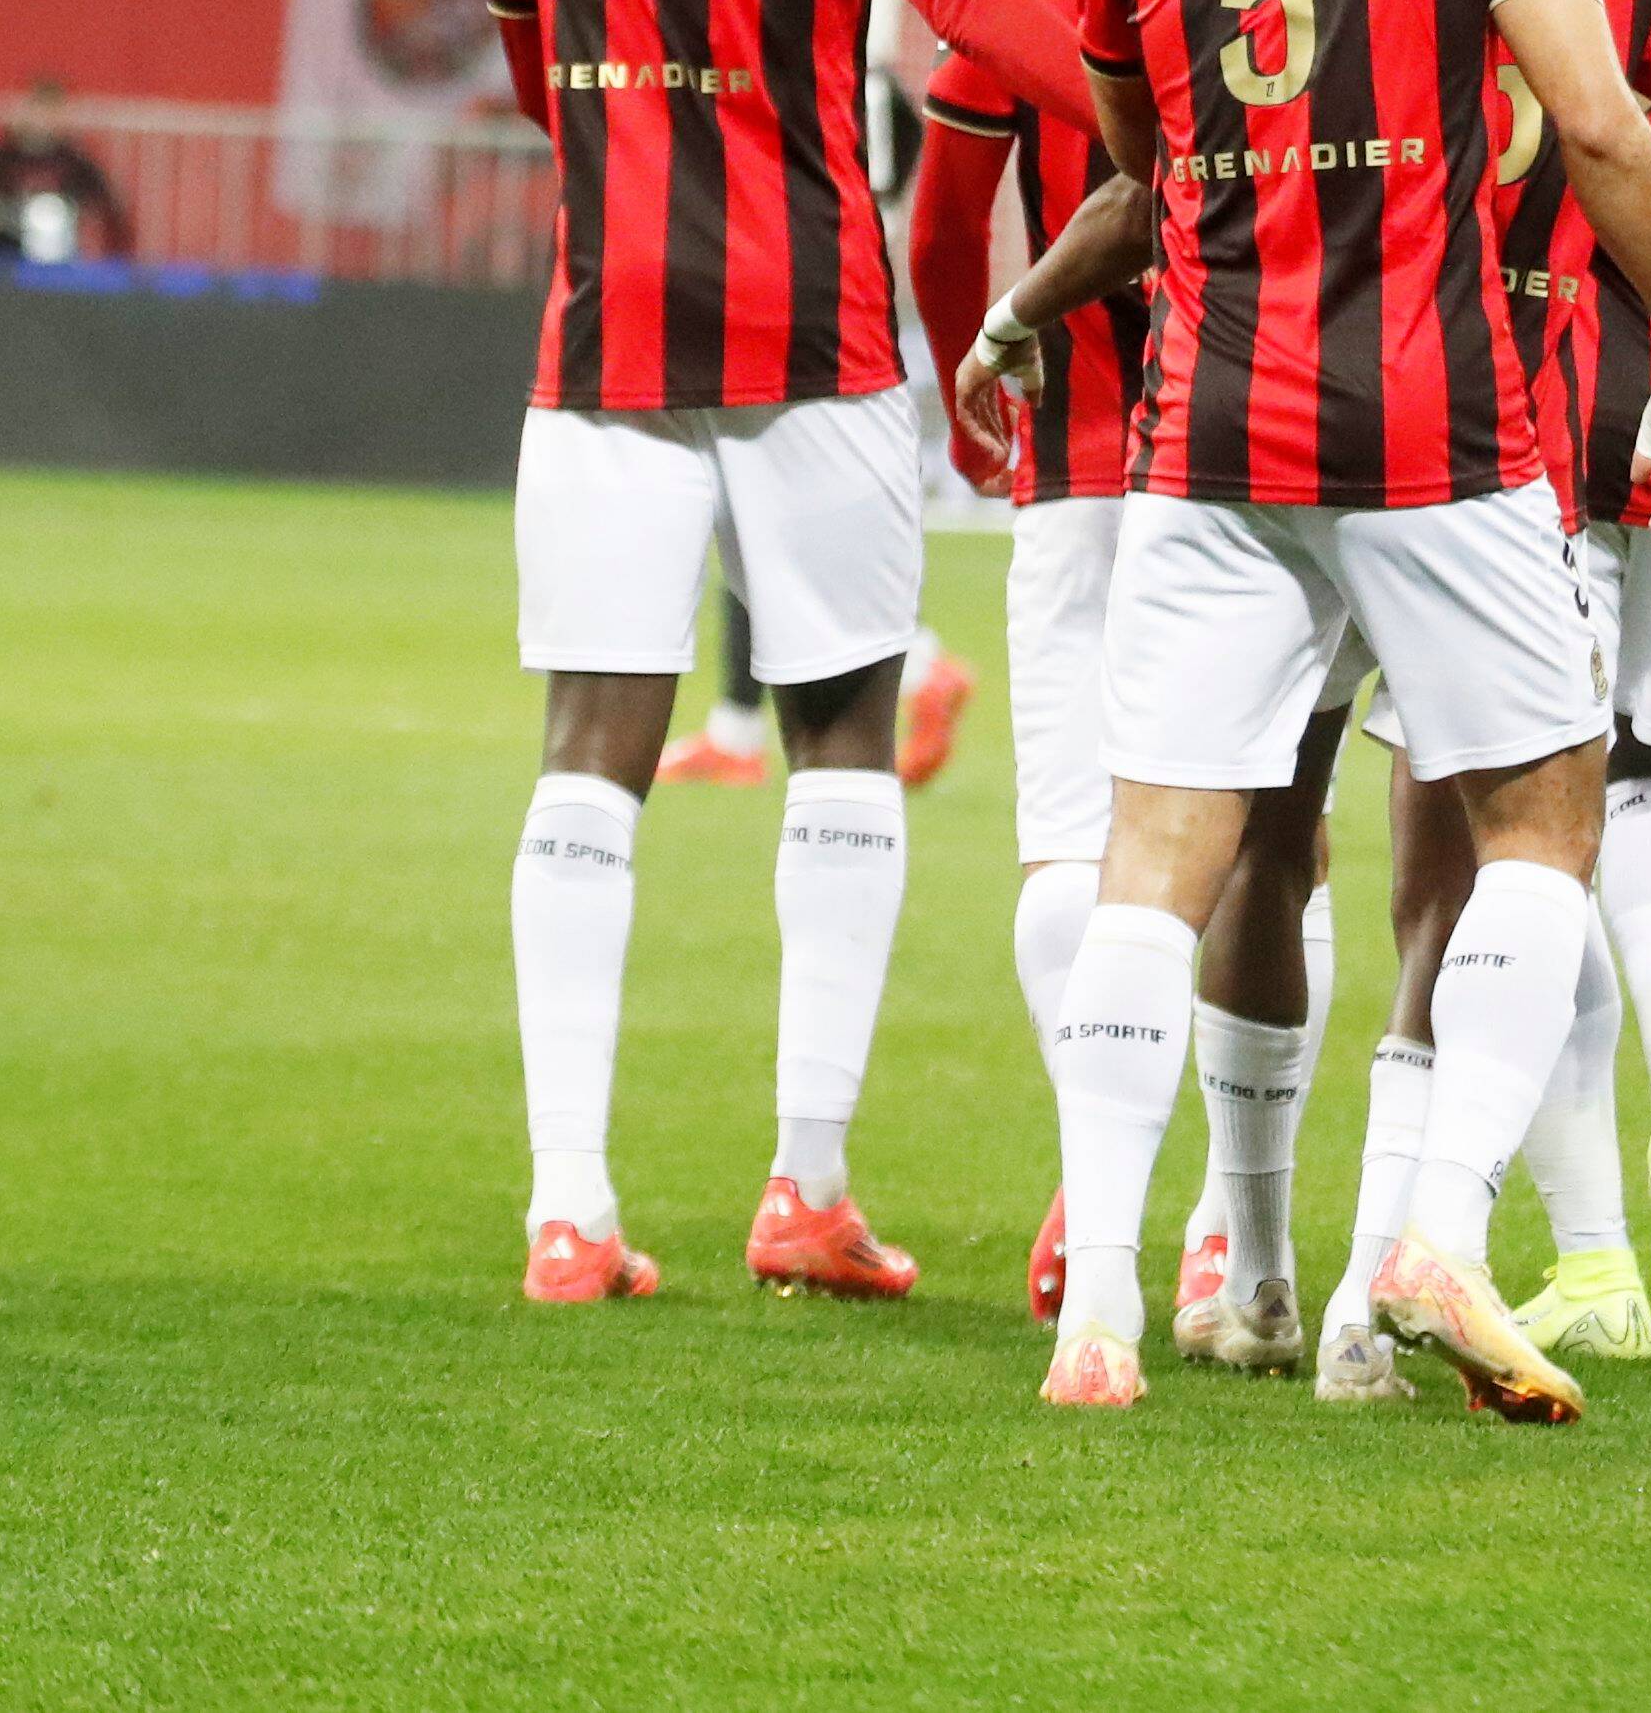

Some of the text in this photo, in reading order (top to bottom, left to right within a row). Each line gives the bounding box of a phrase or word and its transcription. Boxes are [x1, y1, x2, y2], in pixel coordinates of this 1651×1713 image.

[547, 61, 752, 94] RENADIER
[1173, 138, 1426, 183] GRENADIER
[1079, 1024, 1167, 1044] SPORTIF
